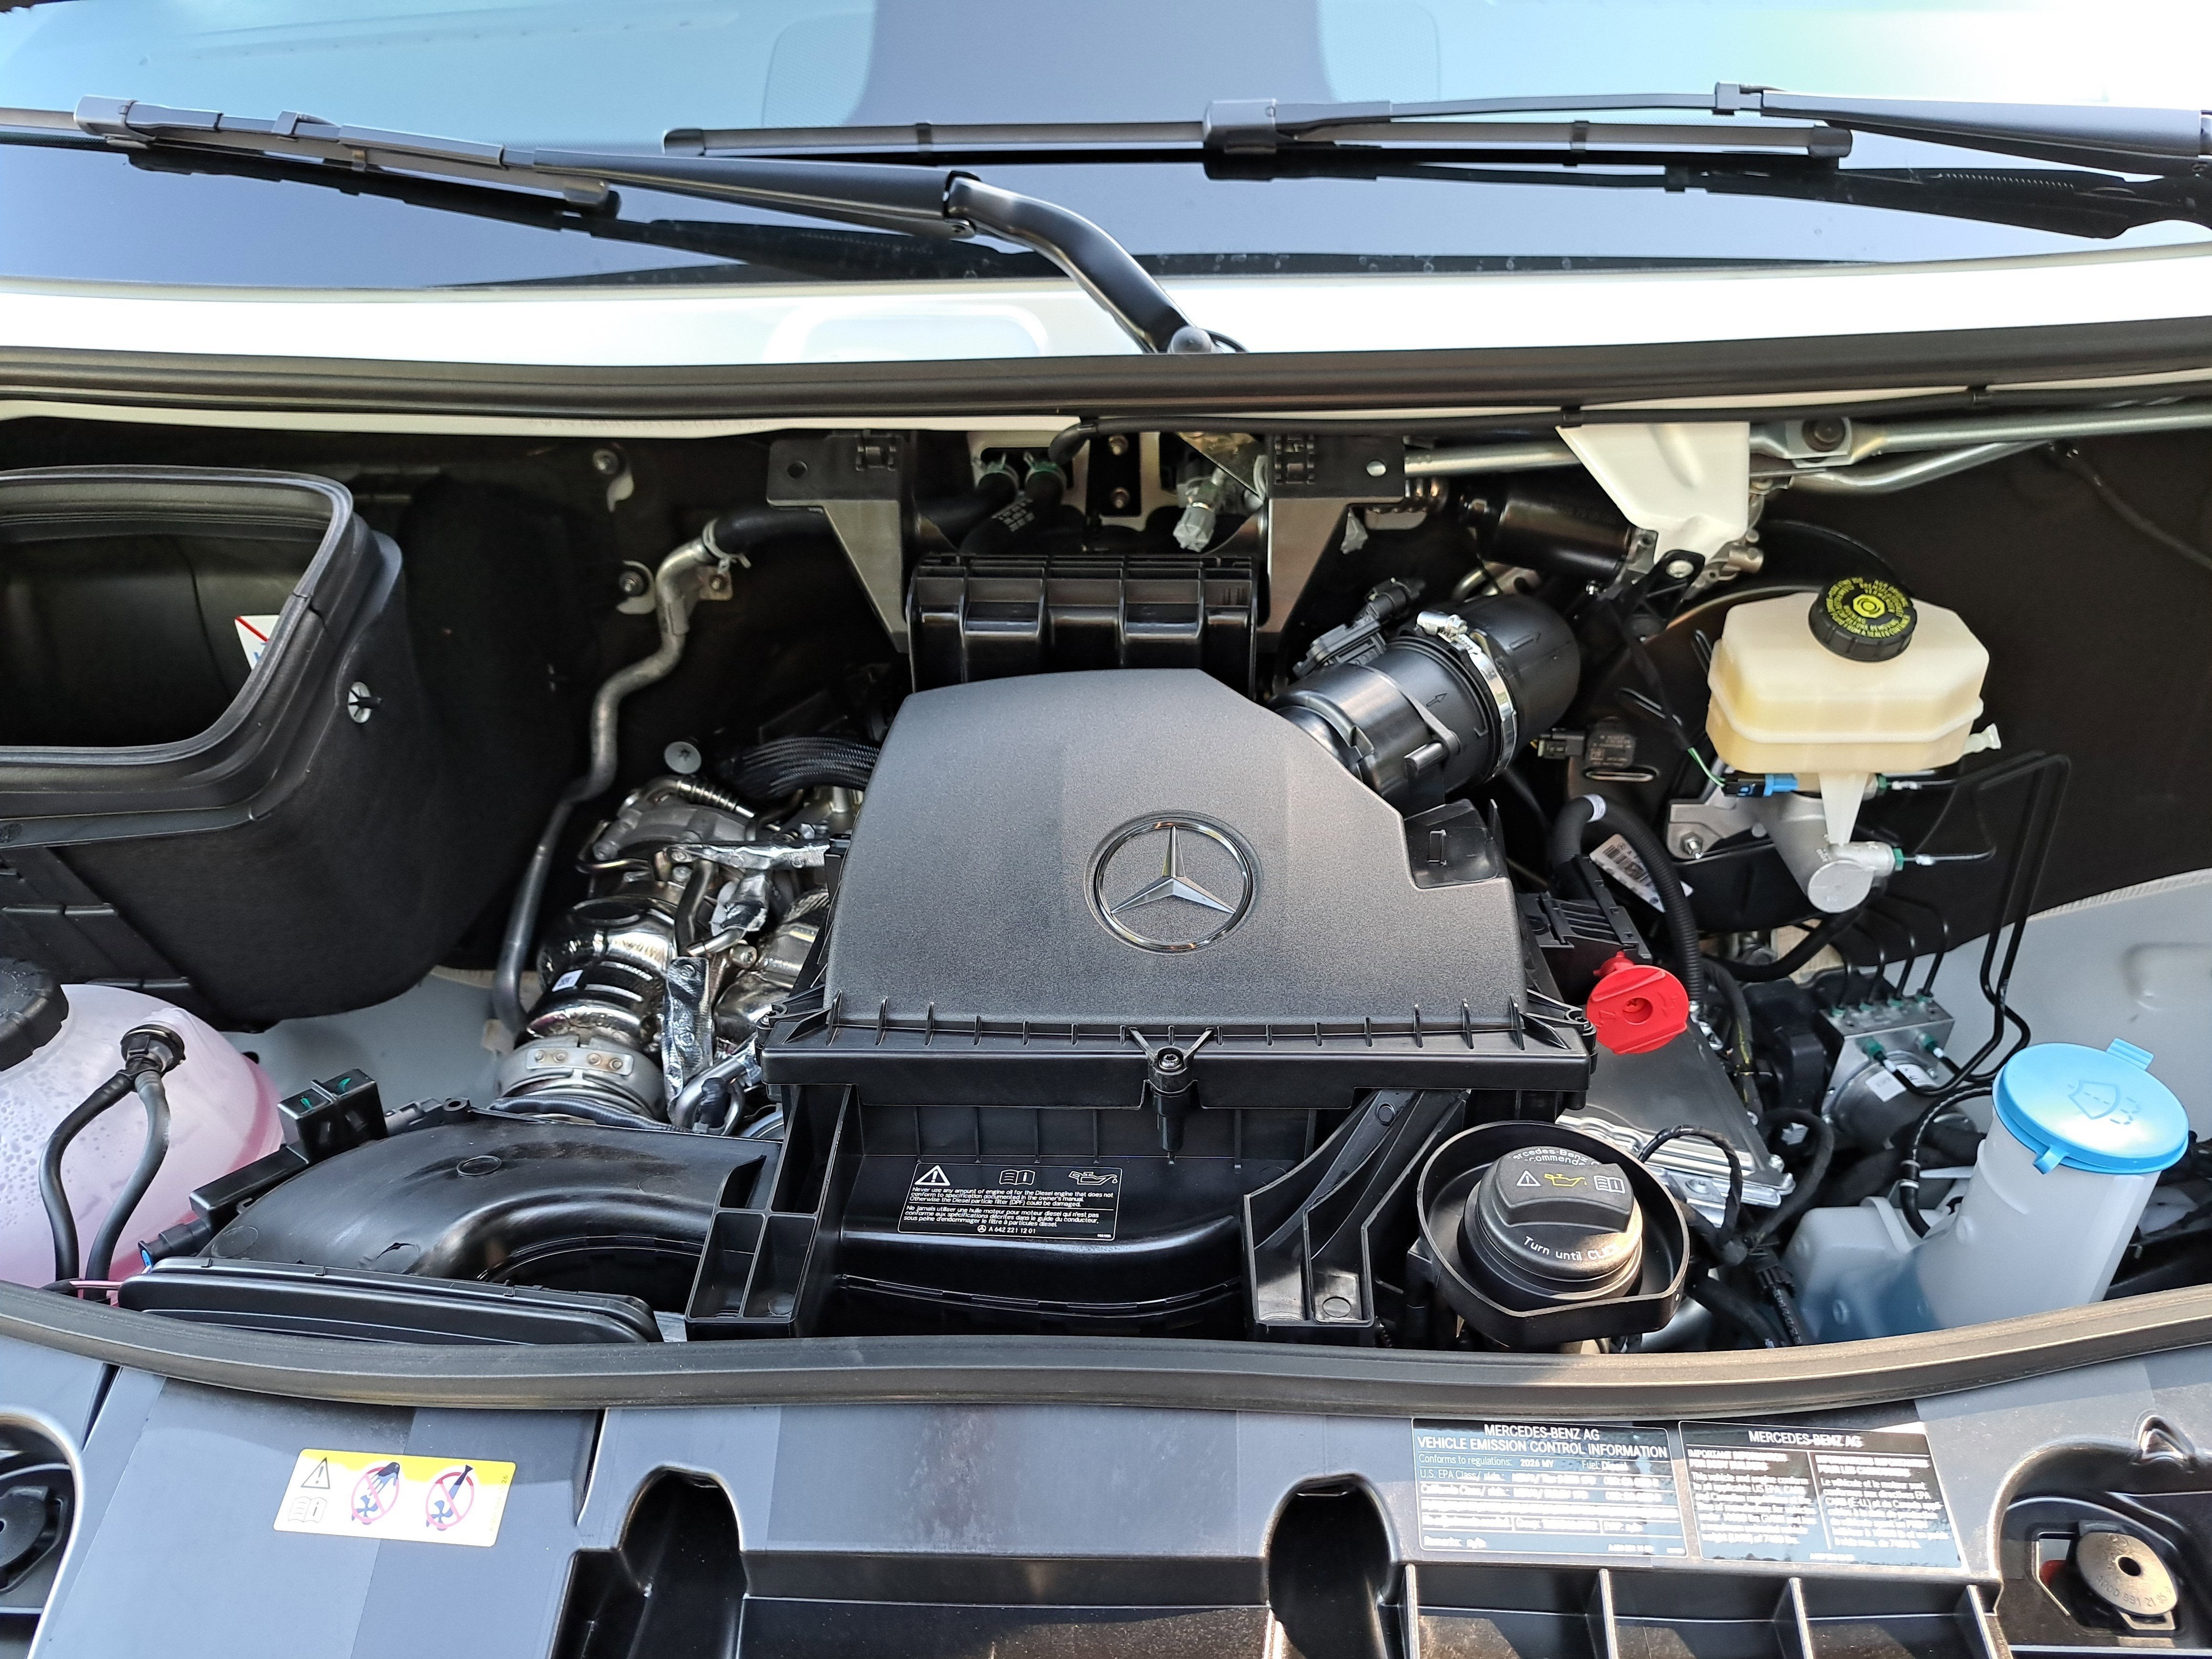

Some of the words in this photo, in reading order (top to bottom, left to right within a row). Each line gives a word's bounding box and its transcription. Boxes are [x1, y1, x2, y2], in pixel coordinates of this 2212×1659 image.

[1512, 1148, 1588, 1162] ercedes-Benz
[1524, 1236, 1549, 1255] Turn
[1555, 1250, 1583, 1261] until
[1483, 1424, 1581, 1440] MERCEDES-BENZ
[1583, 1429, 1599, 1440] AG
[1748, 1430, 1845, 1447] MERCEDES-BENZ
[1845, 1435, 1863, 1448] AG
[1417, 1436, 1467, 1450] VEHICLE
[1470, 1438, 1526, 1452] EMISSION
[1530, 1440, 1585, 1455] CONTROL
[1588, 1444, 1667, 1458] INFORMATION
[1419, 1454, 1456, 1464] Conforms
[1458, 1455, 1466, 1464] to
[1468, 1457, 1513, 1467] regulations:
[1520, 1459, 1540, 1467] 2026
[1542, 1460, 1554, 1468] MY
[1582, 1460, 1600, 1470] Fuel:
[1420, 1469, 1436, 1478] U.S.
[1438, 1470, 1454, 1479] EPA
